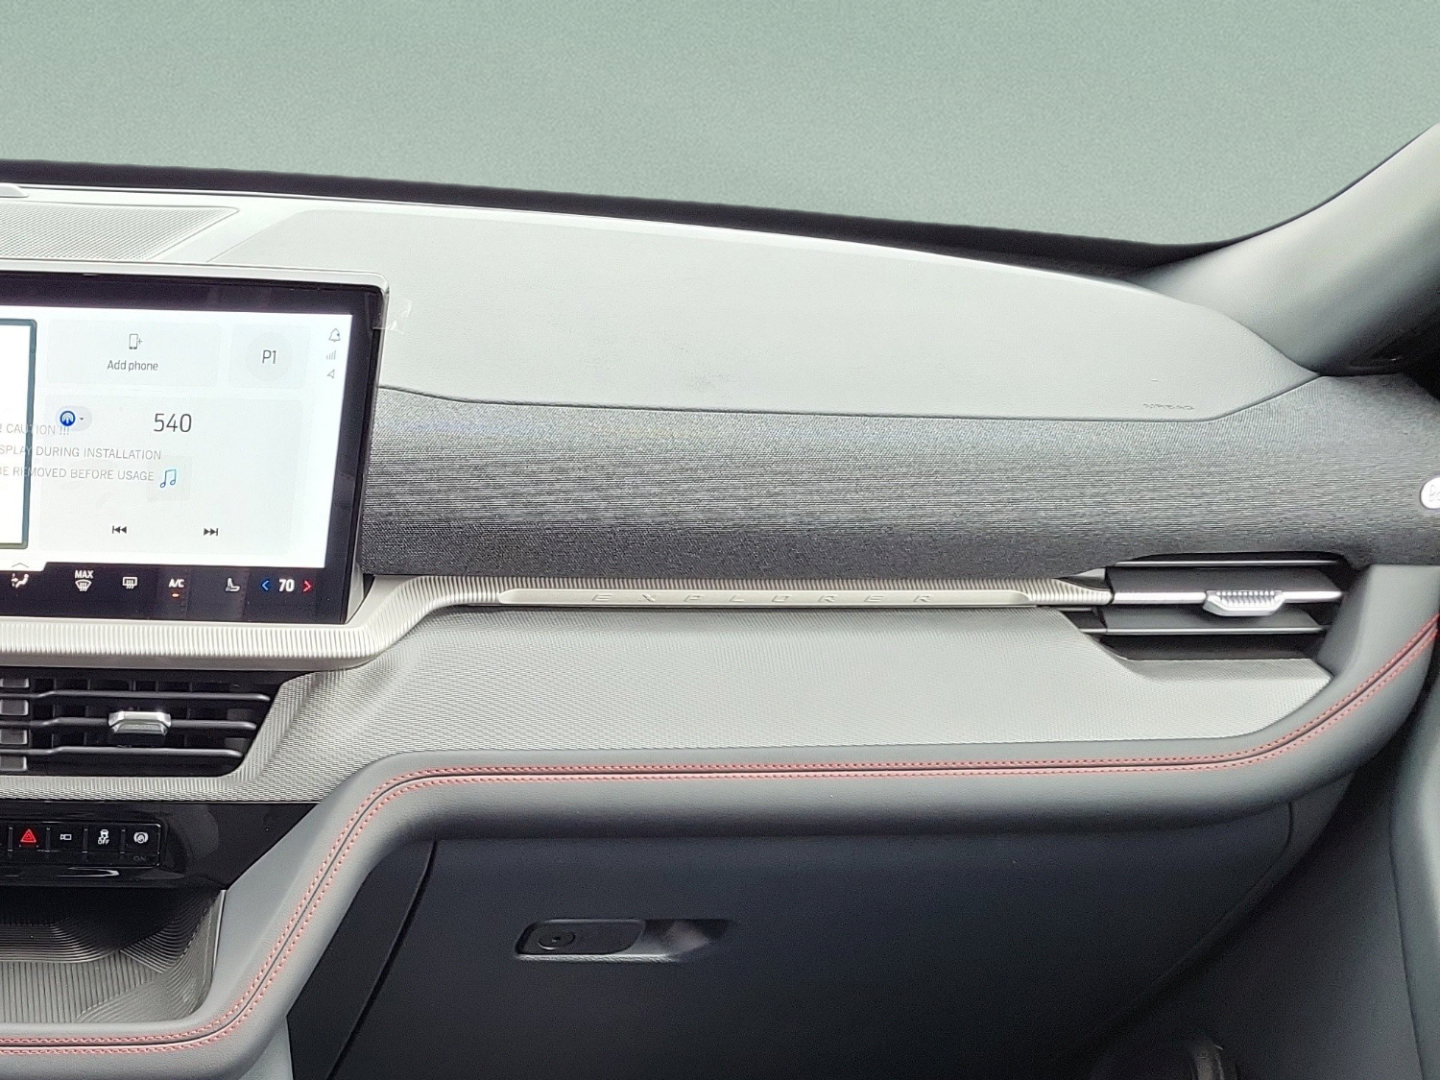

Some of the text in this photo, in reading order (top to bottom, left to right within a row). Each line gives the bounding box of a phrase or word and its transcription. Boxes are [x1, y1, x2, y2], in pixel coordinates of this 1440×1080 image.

[262, 350, 277, 364] P1
[107, 360, 159, 373] Add phone
[6, 423, 56, 435] CAUION
[153, 413, 193, 433] 540
[35, 446, 80, 457] DURING
[84, 448, 161, 460] INSTALLATION
[71, 469, 113, 480] BEFORE
[118, 470, 155, 481] USAGE
[75, 570, 94, 579] MAX
[169, 578, 184, 588] A/C
[279, 579, 295, 592] 70
